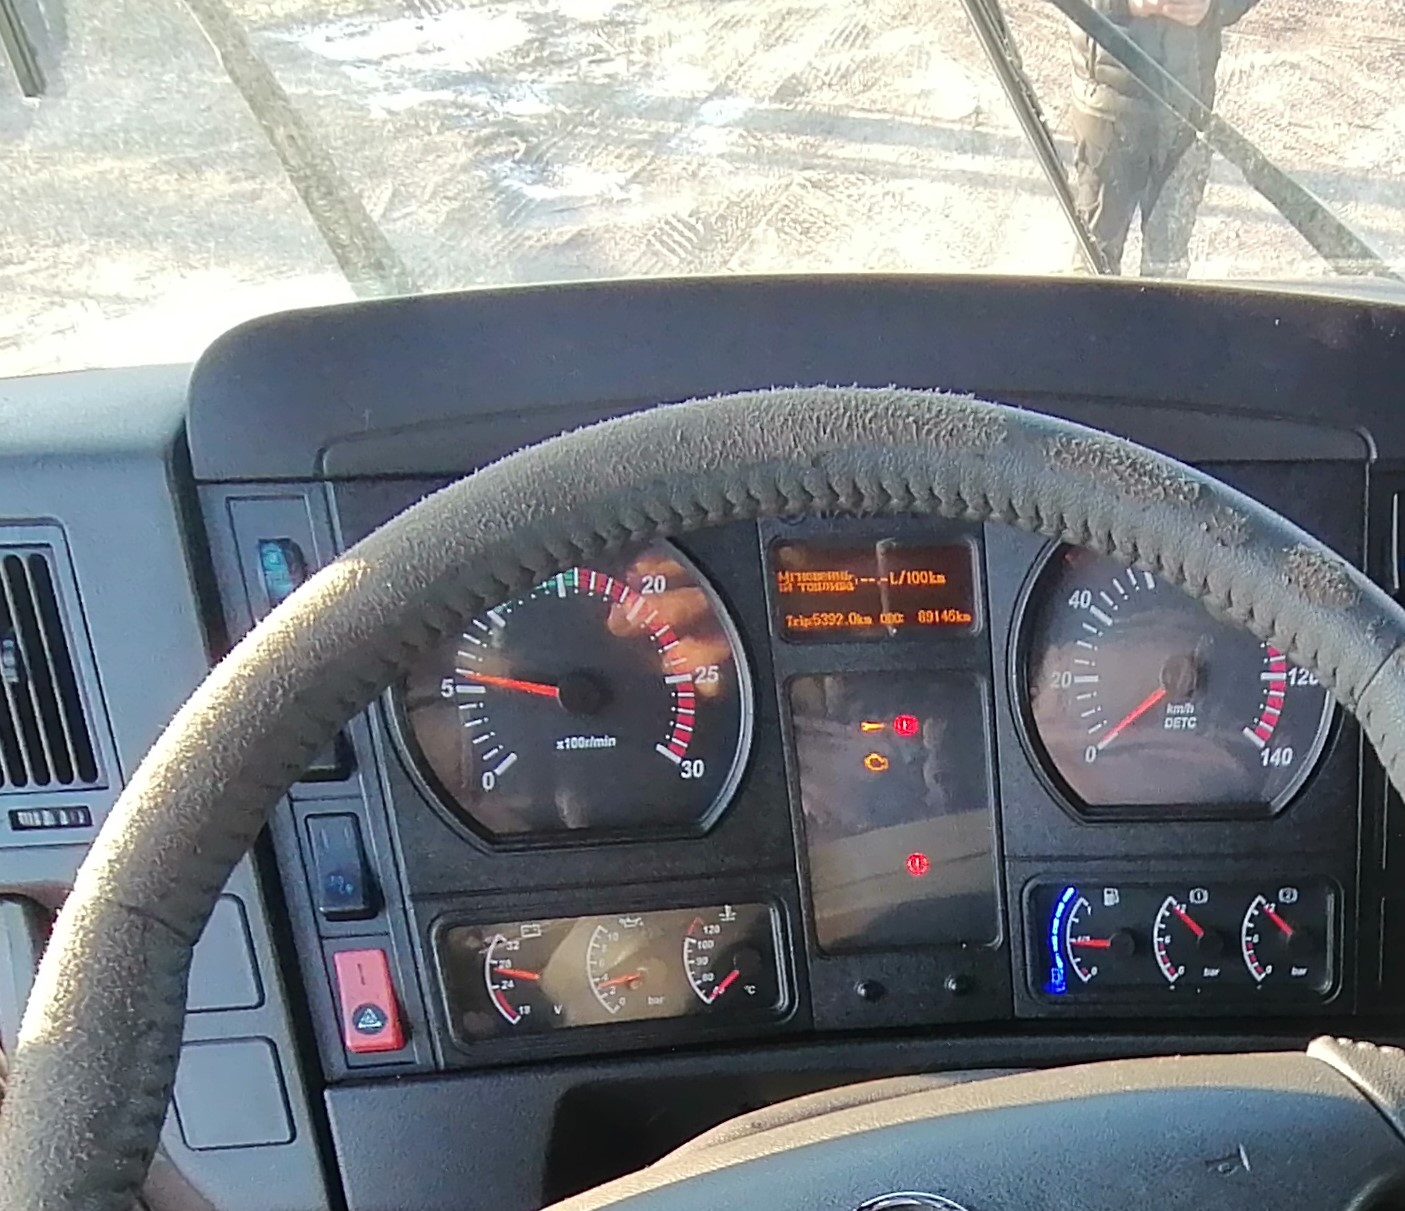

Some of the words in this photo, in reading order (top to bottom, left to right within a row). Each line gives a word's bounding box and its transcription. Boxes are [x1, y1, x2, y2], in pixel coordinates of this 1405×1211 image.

[642, 575, 666, 594] 20
[1069, 590, 1092, 608] 40
[695, 666, 719, 684] 25
[1051, 671, 1072, 688] 20
[441, 679, 454, 698] 5
[1166, 703, 1194, 715] km/h
[1085, 747, 1096, 763] 0
[1260, 747, 1293, 766] 140
[681, 759, 704, 778] 30
[482, 771, 494, 790] 0
[703, 924, 720, 934] 120
[506, 940, 520, 950] 32
[697, 940, 715, 950] 100
[1203, 967, 1220, 977] bar
[1291, 966, 1308, 976] bar
[501, 980, 514, 990] 24
[553, 1004, 562, 1015] V
